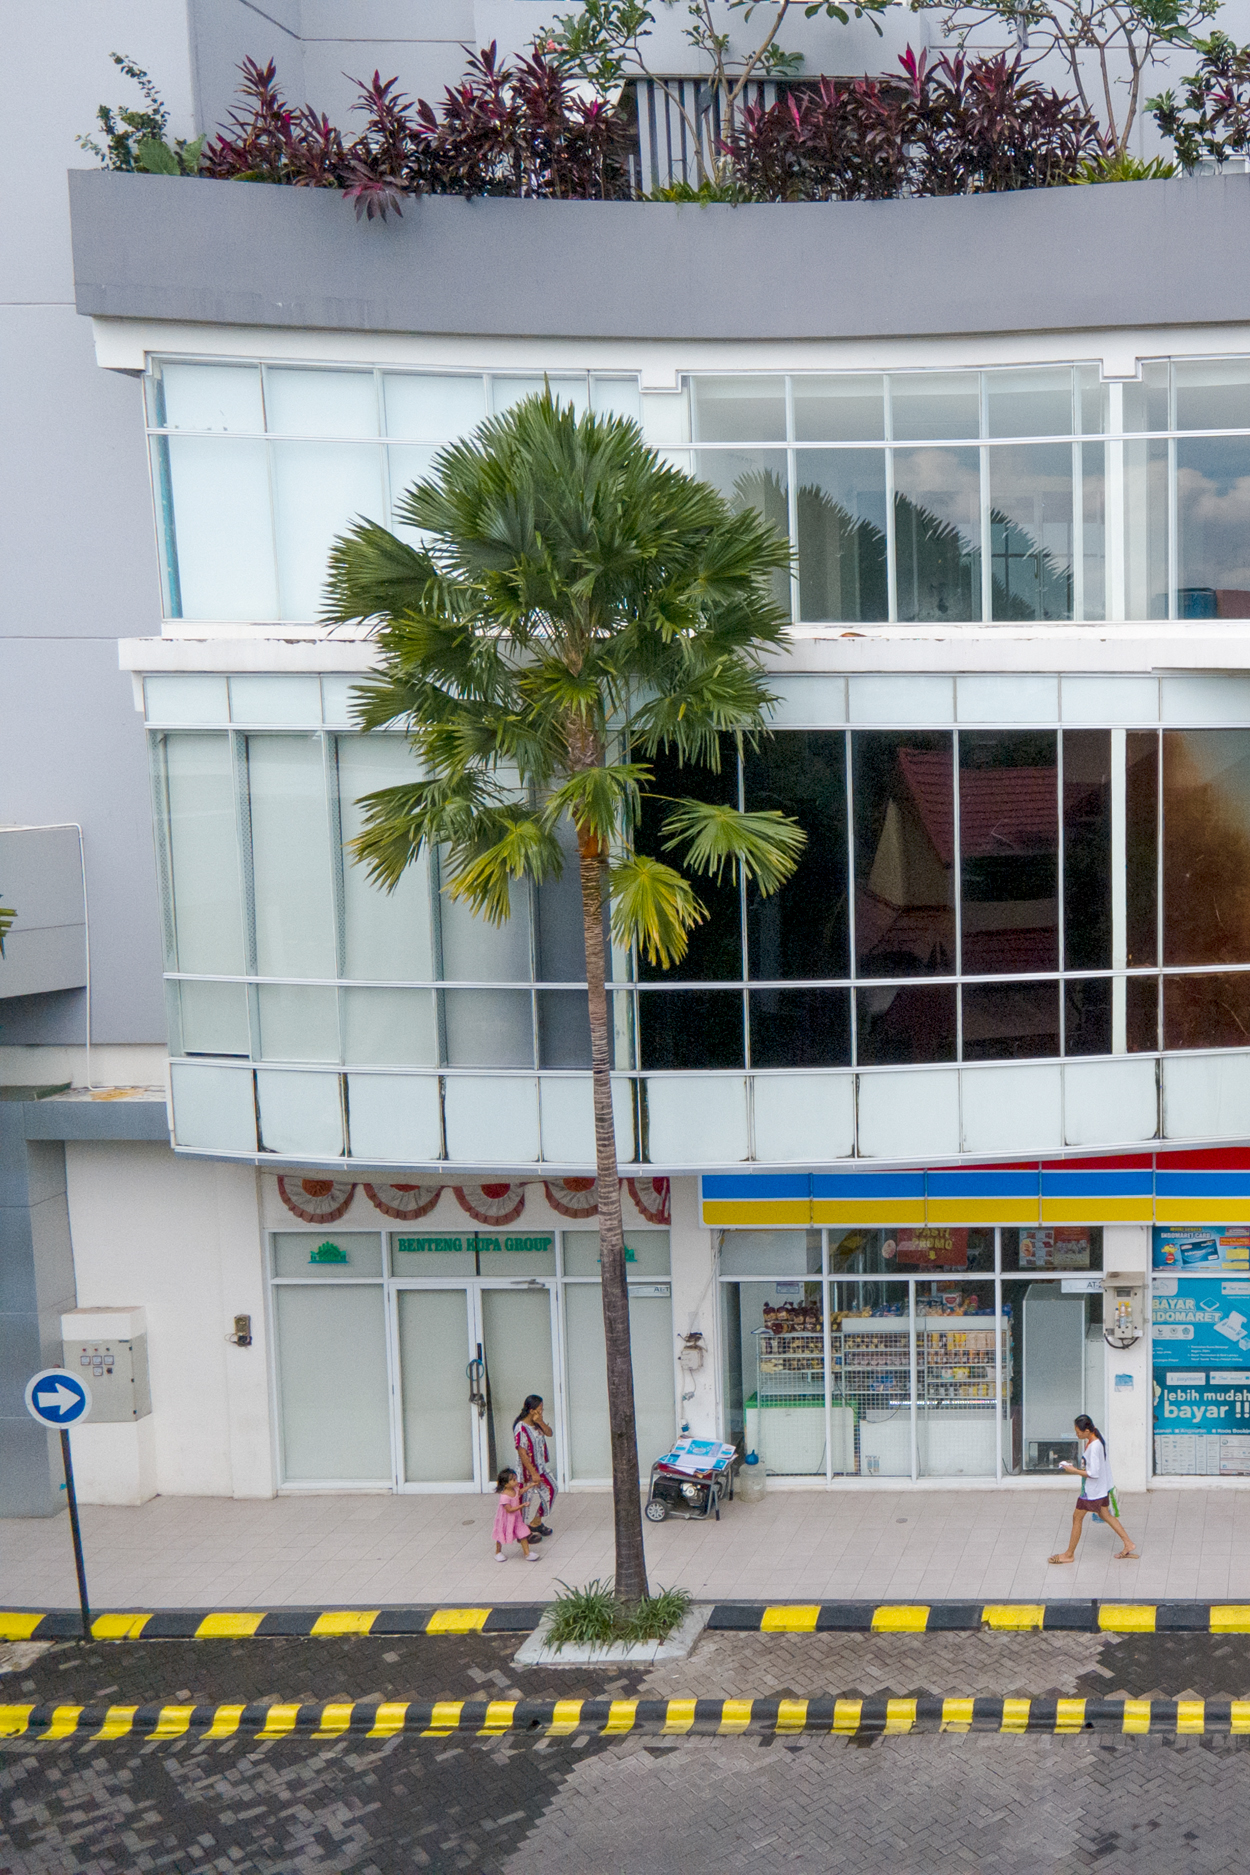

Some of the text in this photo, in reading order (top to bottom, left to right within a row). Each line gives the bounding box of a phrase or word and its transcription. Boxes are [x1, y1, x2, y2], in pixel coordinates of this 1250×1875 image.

[398, 1237, 552, 1252] BENTENG KUPA GROUP
[911, 1237, 953, 1250] PROMO
[1152, 1298, 1195, 1310] BAYAR
[1164, 1389, 1200, 1401] lebih
[1164, 1401, 1229, 1423] bayar
